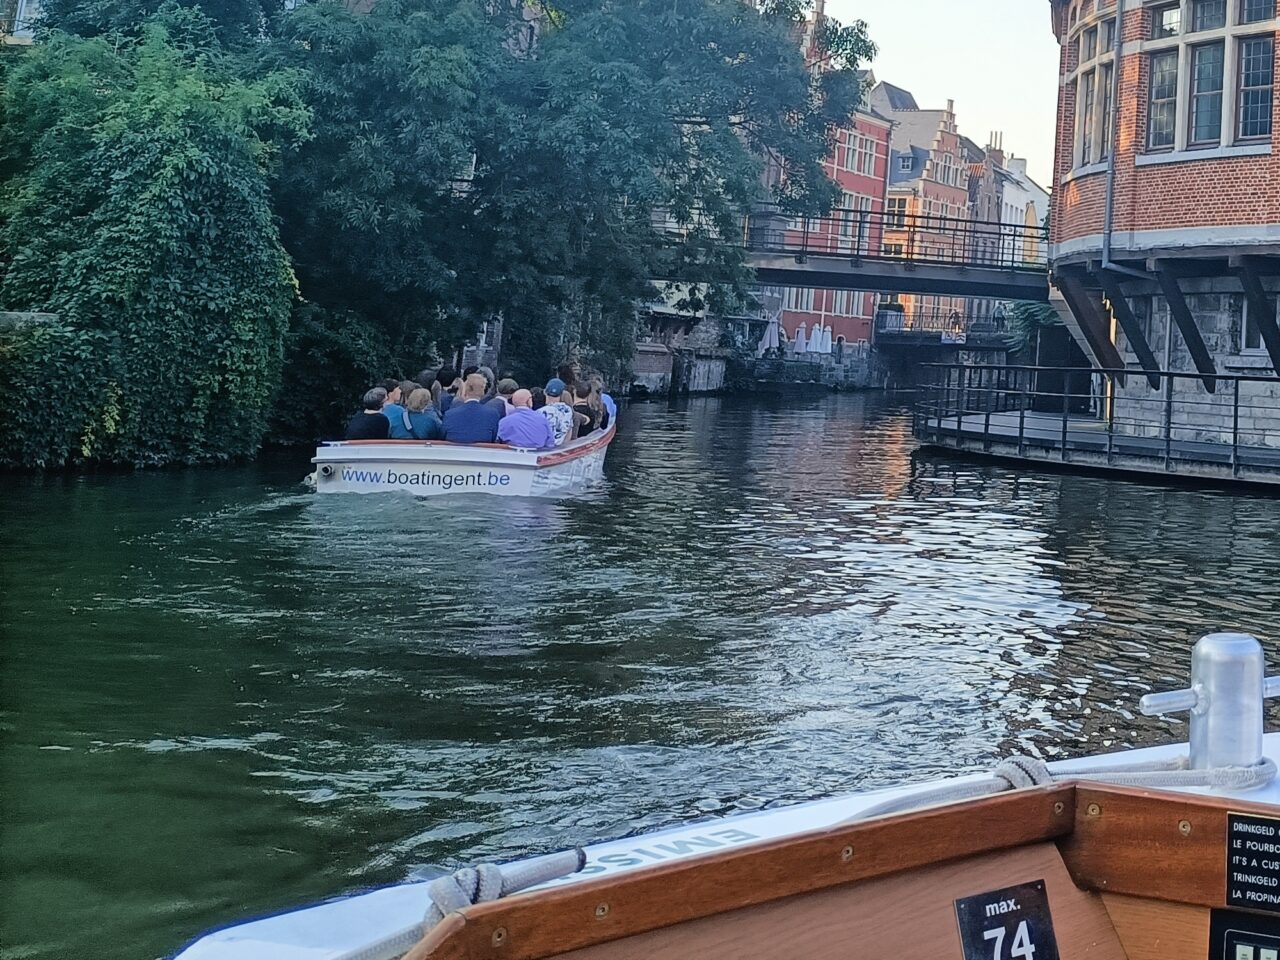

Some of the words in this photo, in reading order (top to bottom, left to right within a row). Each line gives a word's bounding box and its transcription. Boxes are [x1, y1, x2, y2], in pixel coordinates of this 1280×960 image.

[341, 469, 511, 489] www.boatingent.be
[1233, 822, 1275, 836] DRINKGELD
[1233, 839, 1242, 849] LE
[1232, 856, 1247, 866] IT'S
[1251, 858, 1258, 867] A
[1233, 872, 1278, 887] TRINKGELD
[1232, 889, 1242, 899] LA
[985, 898, 1021, 917] max.
[983, 920, 1036, 960] 74
